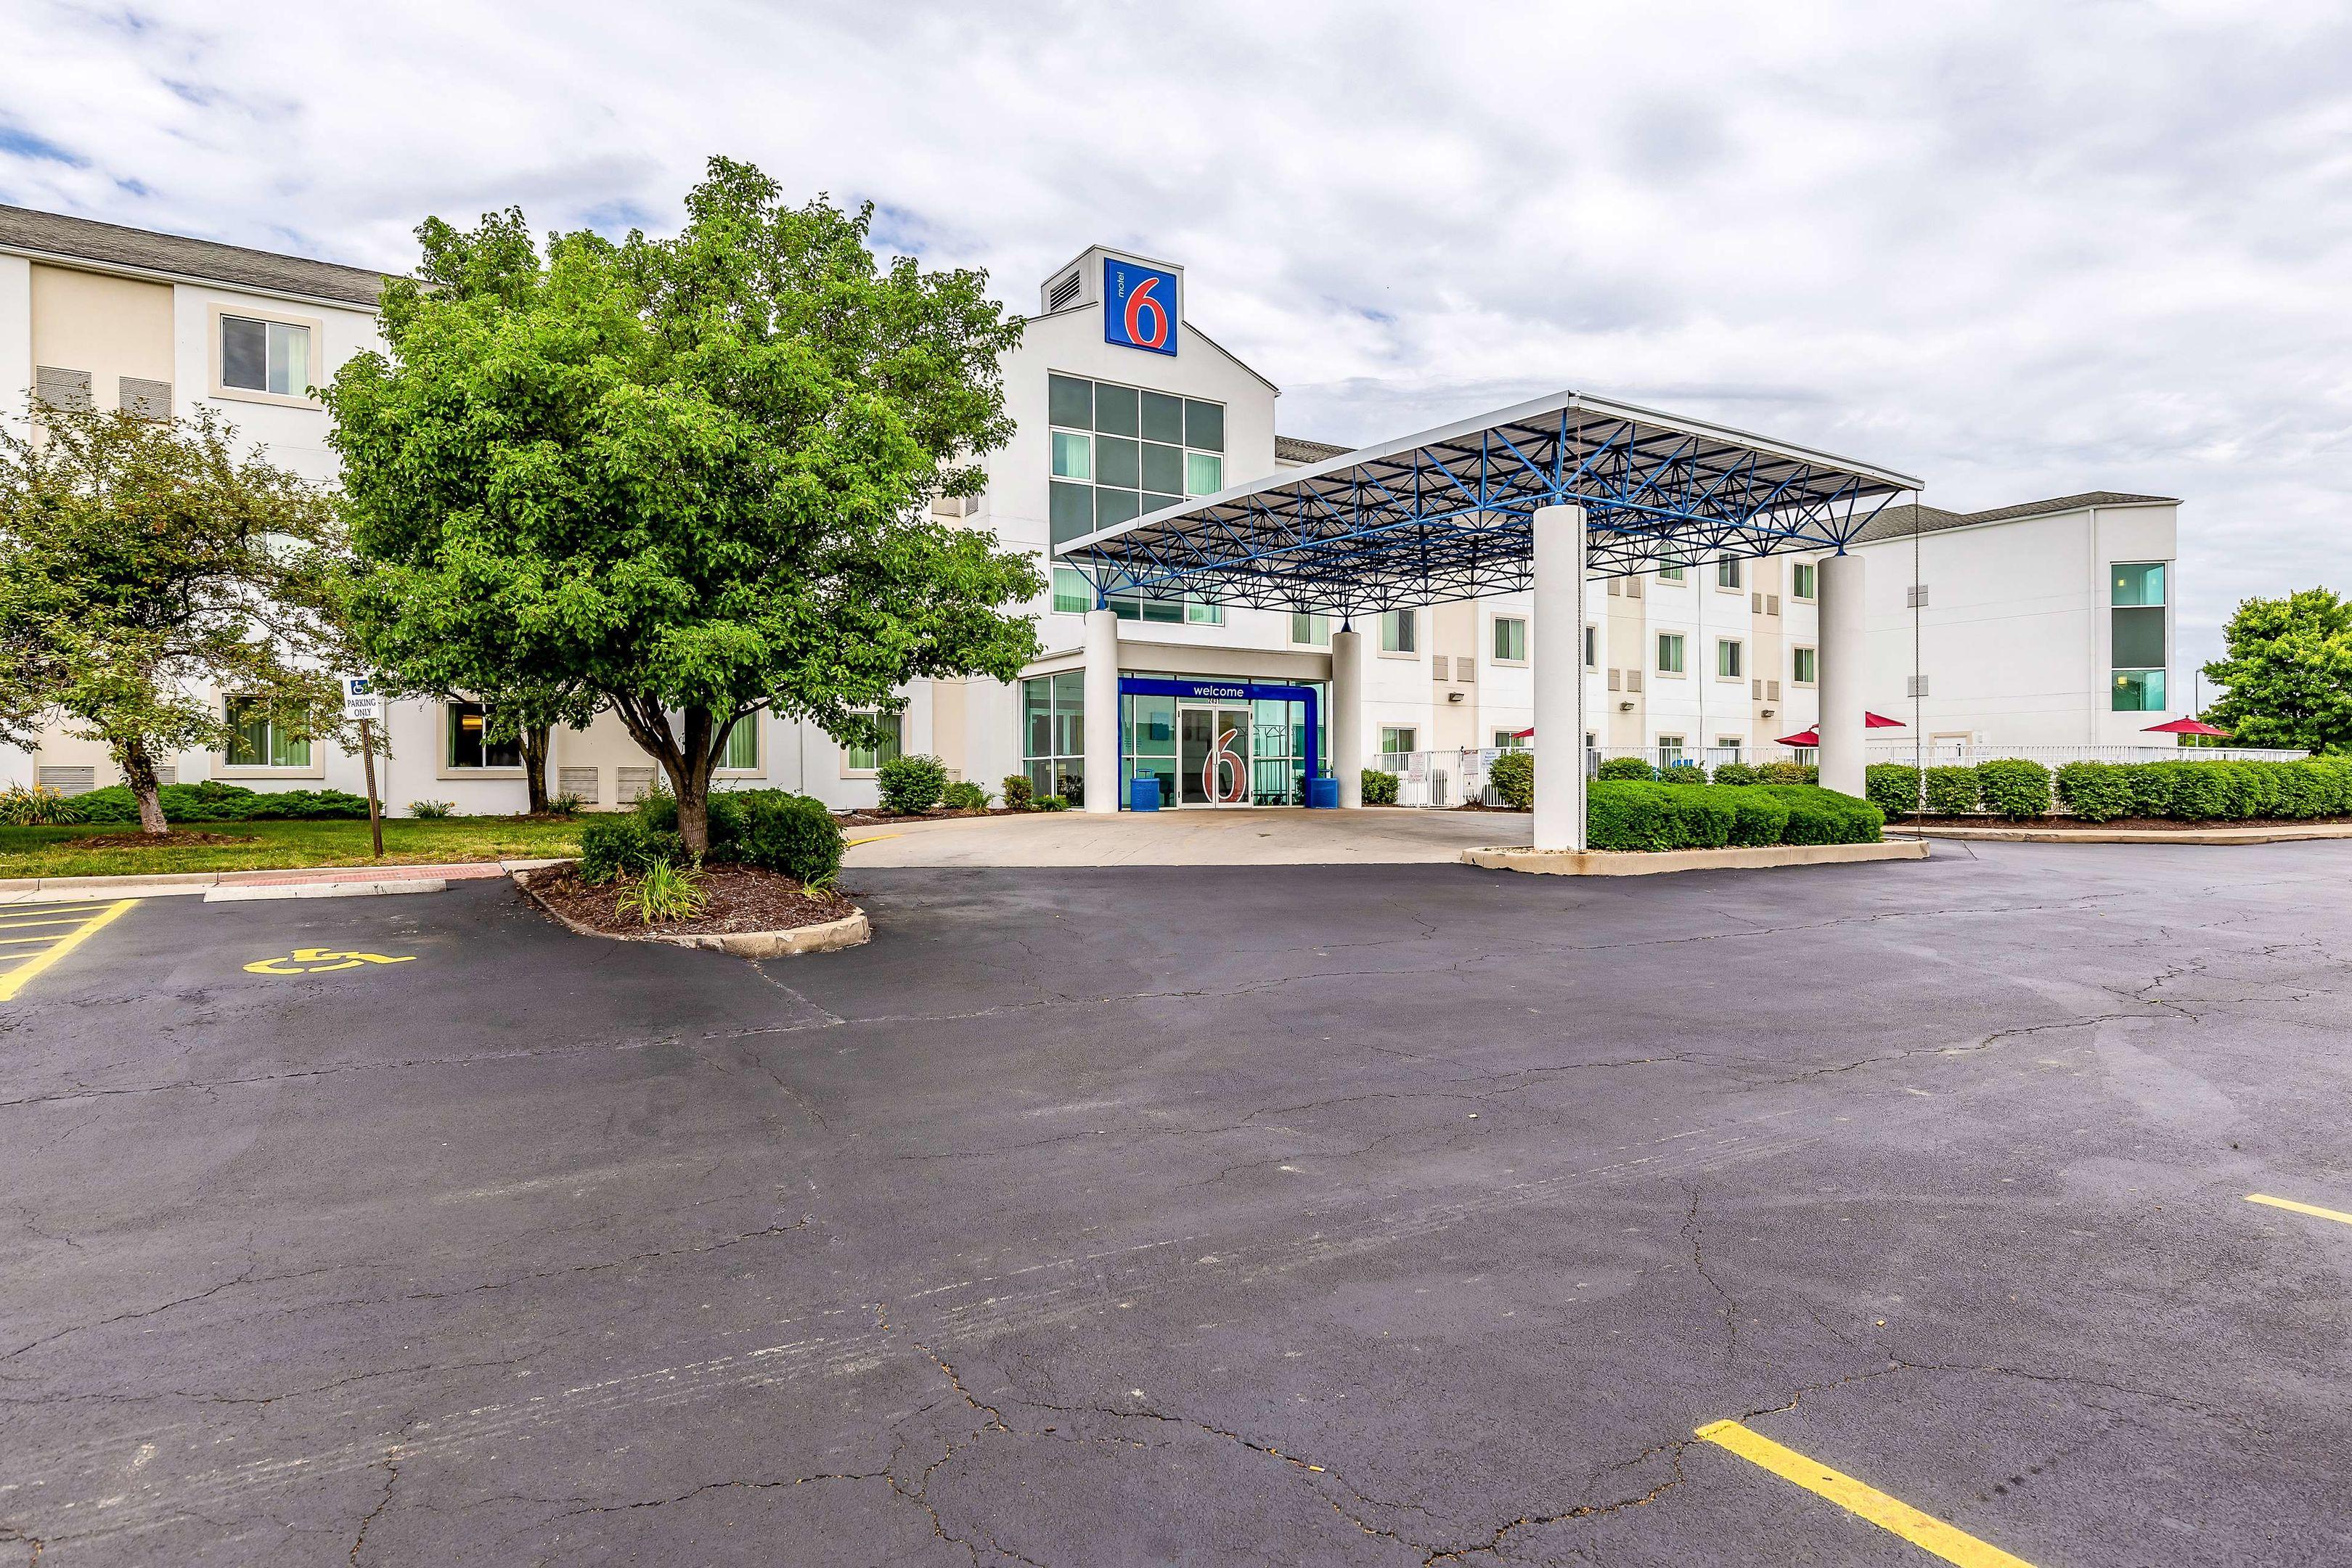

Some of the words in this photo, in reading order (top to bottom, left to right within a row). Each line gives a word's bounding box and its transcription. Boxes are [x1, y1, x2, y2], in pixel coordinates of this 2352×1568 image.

[1124, 277, 1168, 348] 6
[1193, 685, 1244, 698] welcome
[347, 698, 376, 708] PARKING
[354, 708, 371, 717] ONLY
